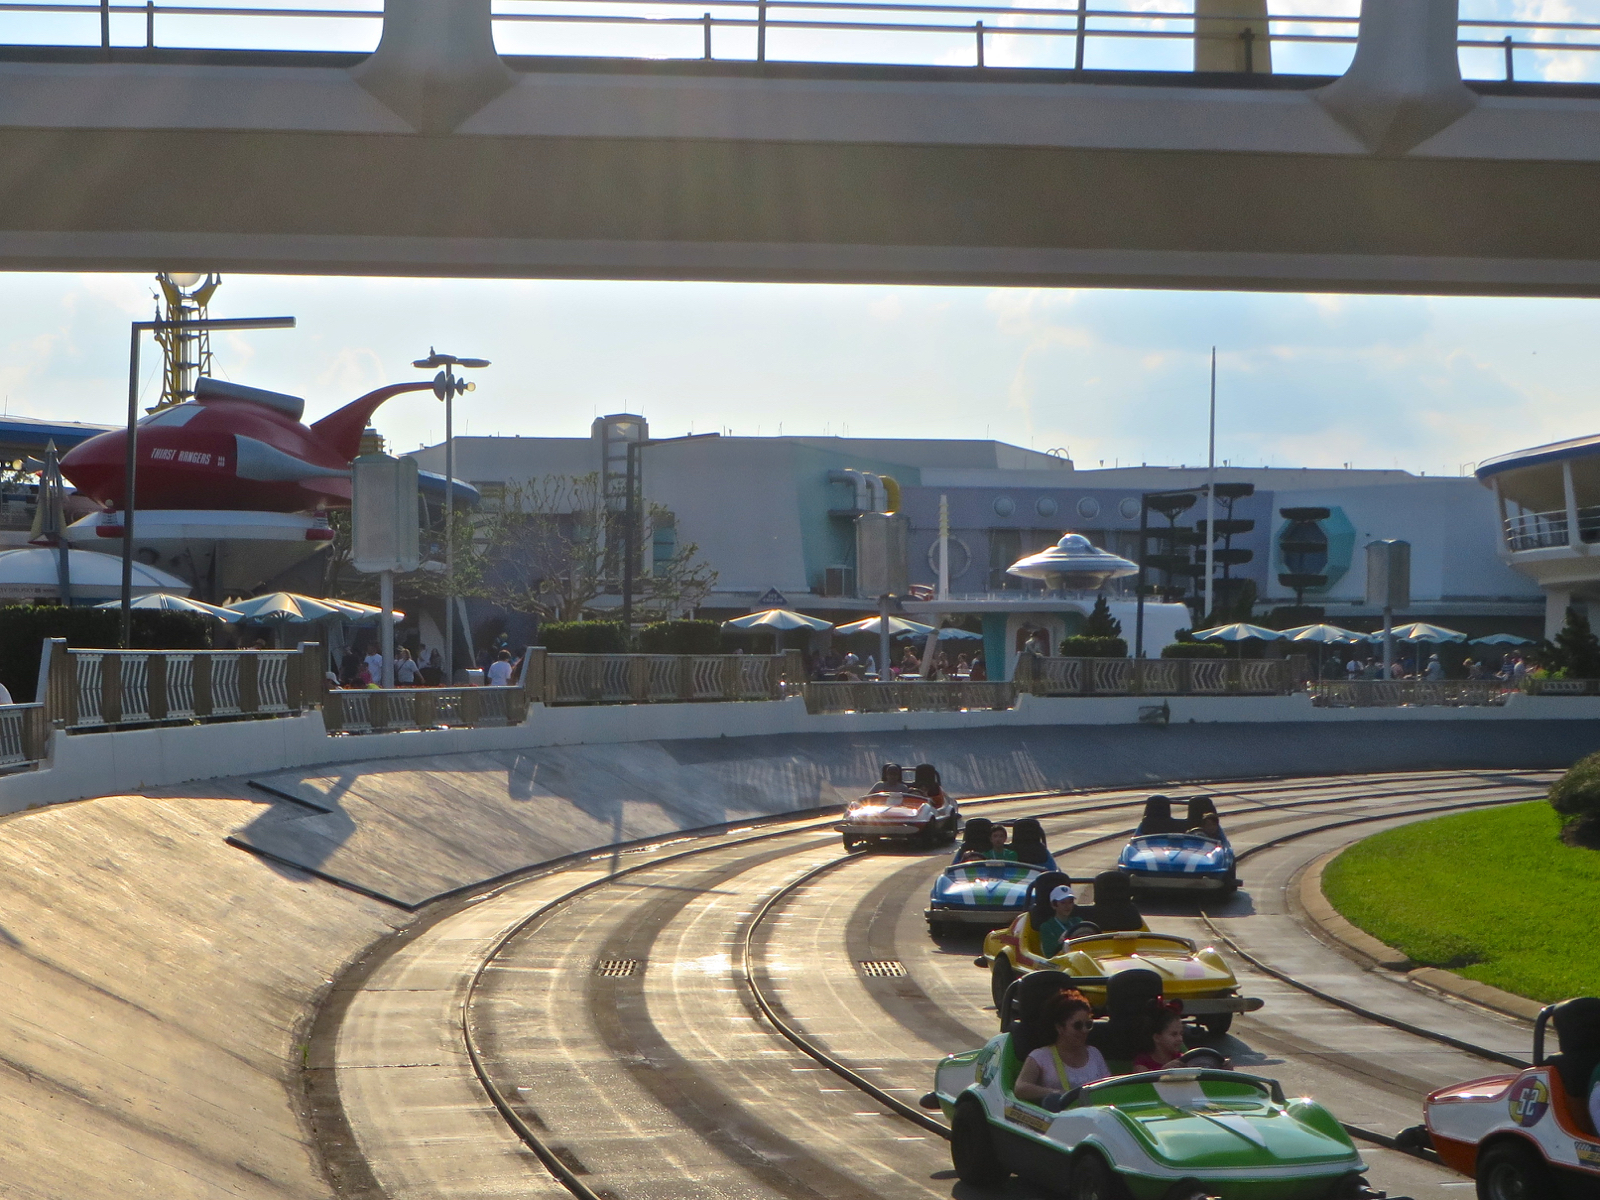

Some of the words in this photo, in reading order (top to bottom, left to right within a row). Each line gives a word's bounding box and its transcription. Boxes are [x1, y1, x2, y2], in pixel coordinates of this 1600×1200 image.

[151, 448, 177, 460] THIRST
[178, 450, 211, 465] RANGERS
[1517, 1088, 1539, 1116] 52
